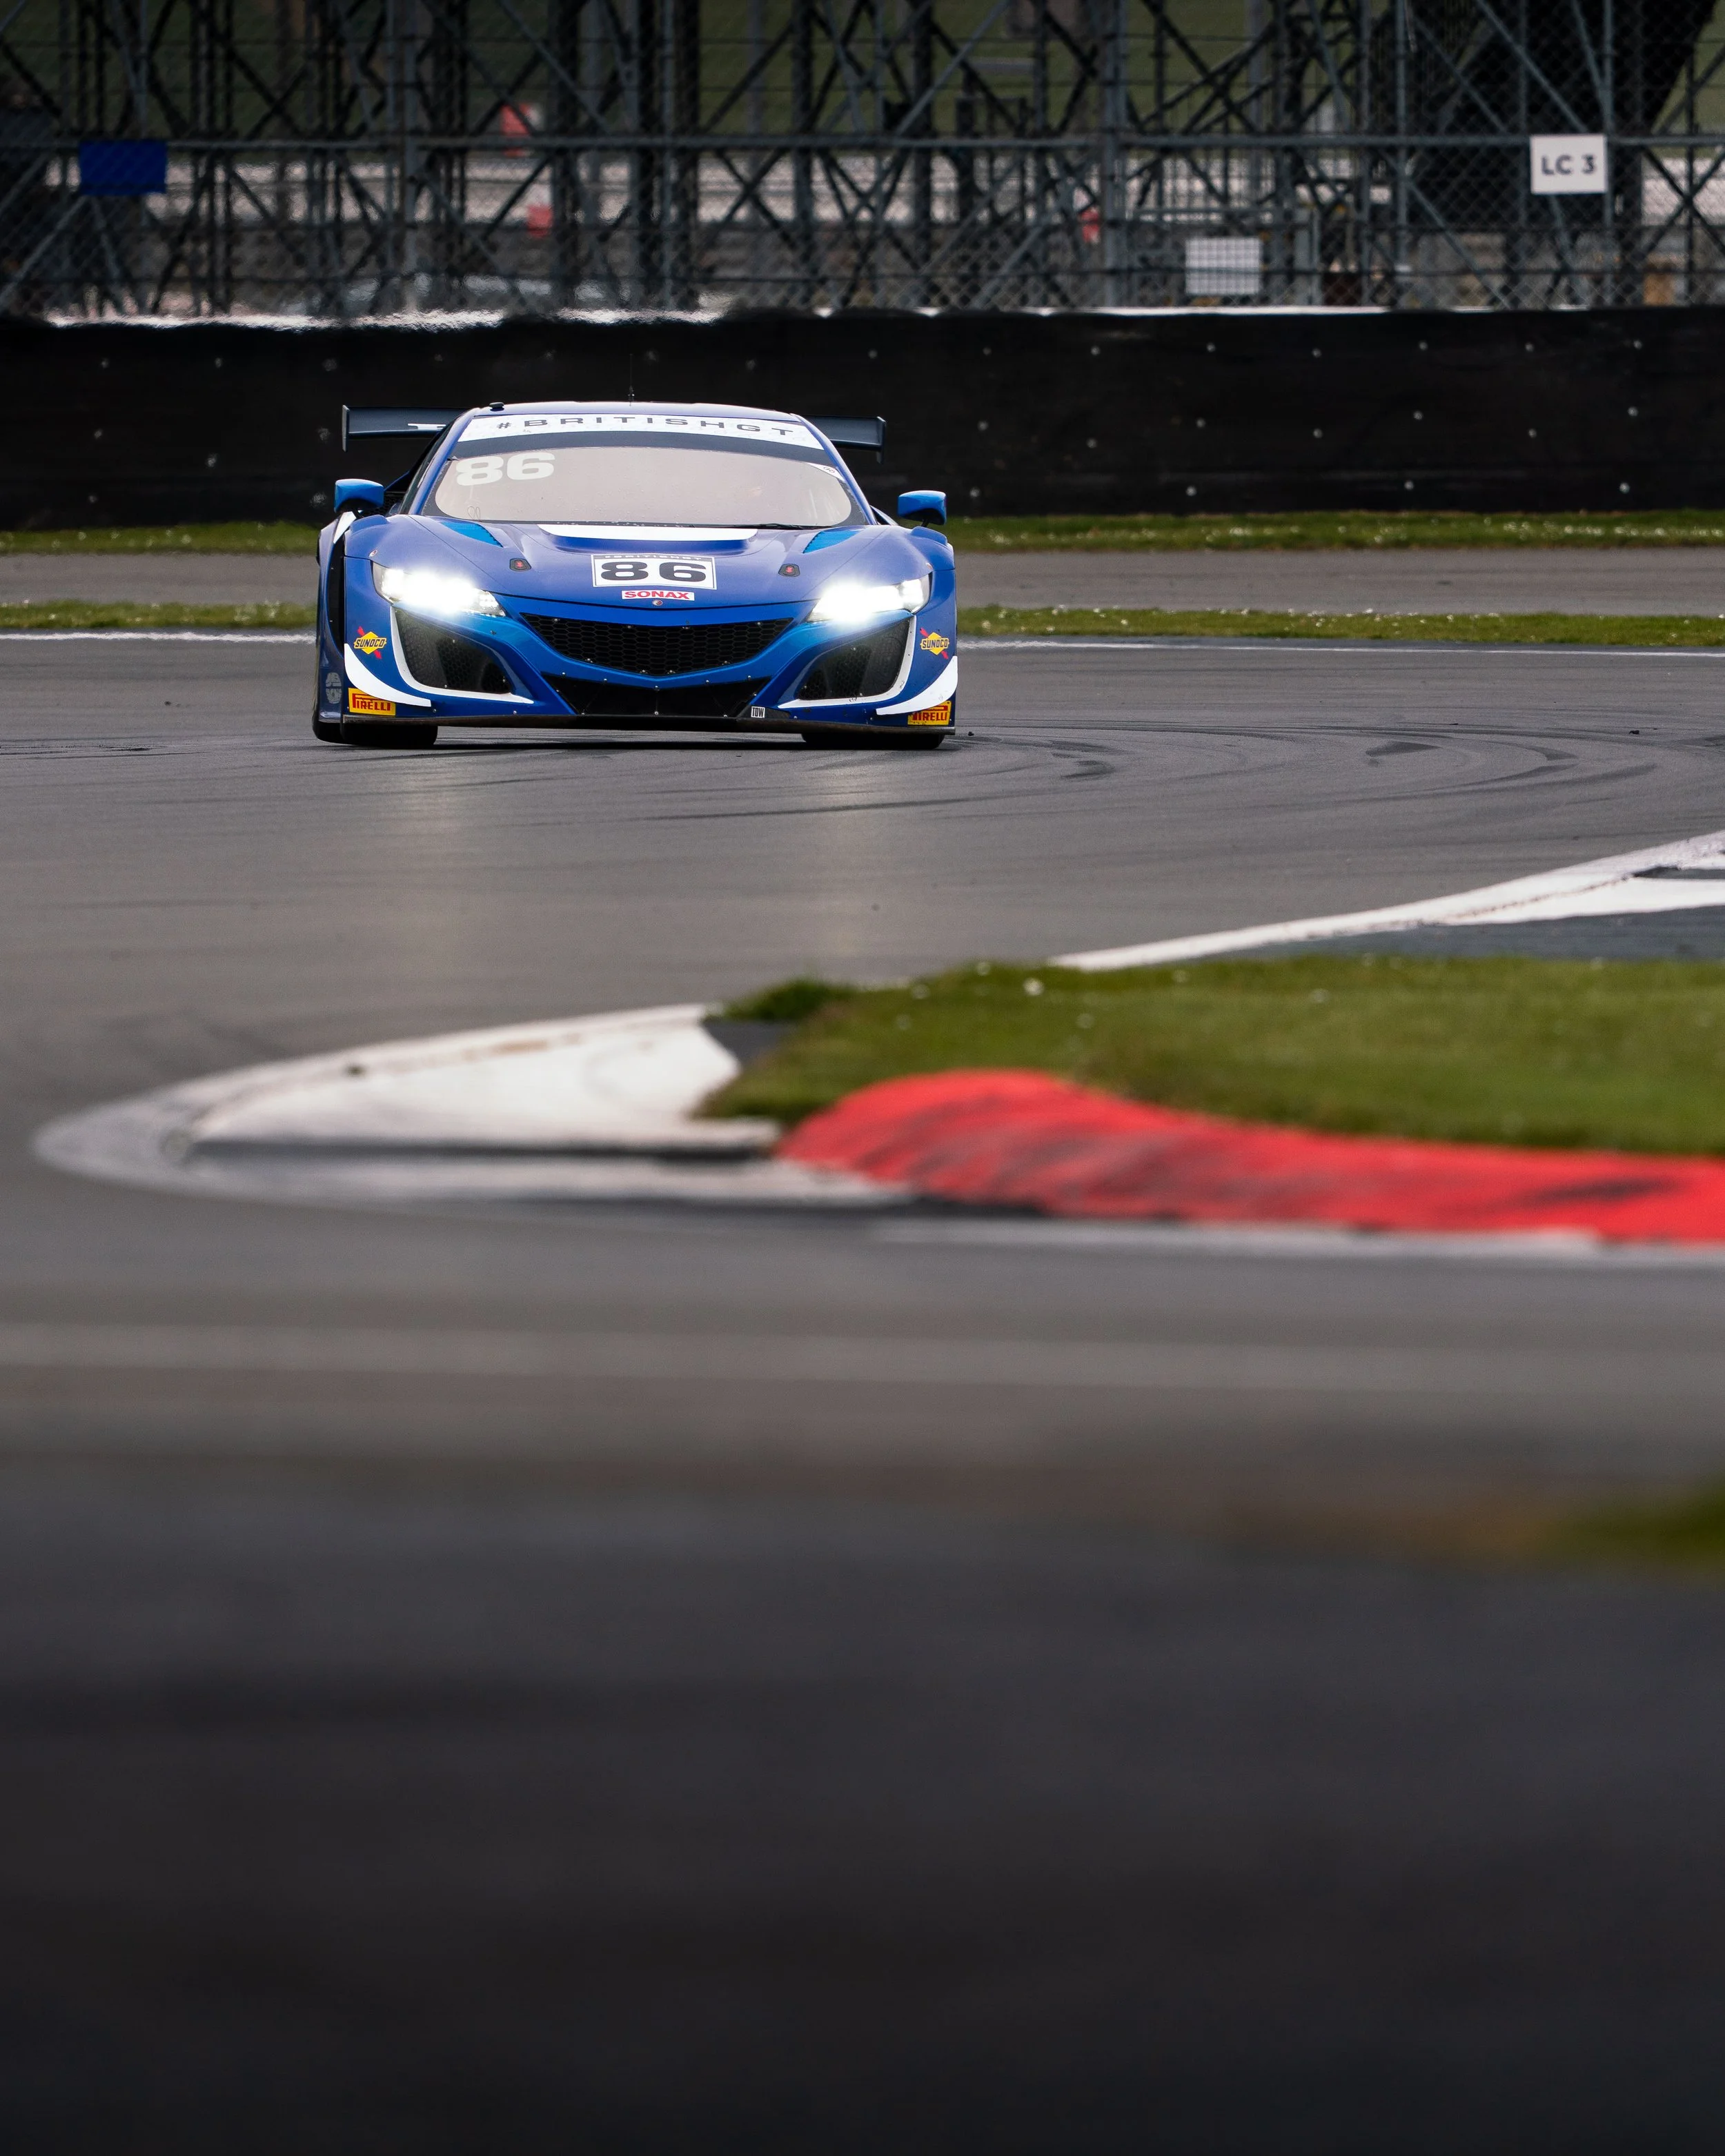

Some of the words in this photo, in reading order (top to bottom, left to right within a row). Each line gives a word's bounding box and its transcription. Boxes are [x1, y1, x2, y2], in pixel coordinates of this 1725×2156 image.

[1541, 155, 1573, 175] LC
[1581, 154, 1595, 174] 3
[496, 417, 793, 435] #BRITISHGT
[456, 452, 555, 486] 86
[601, 562, 707, 582] 86
[624, 591, 690, 600] SONAX
[355, 638, 386, 648] SUNOCO
[922, 639, 949, 649] SUNOCO
[352, 693, 391, 711] PIRELLI
[752, 707, 765, 718] TOW
